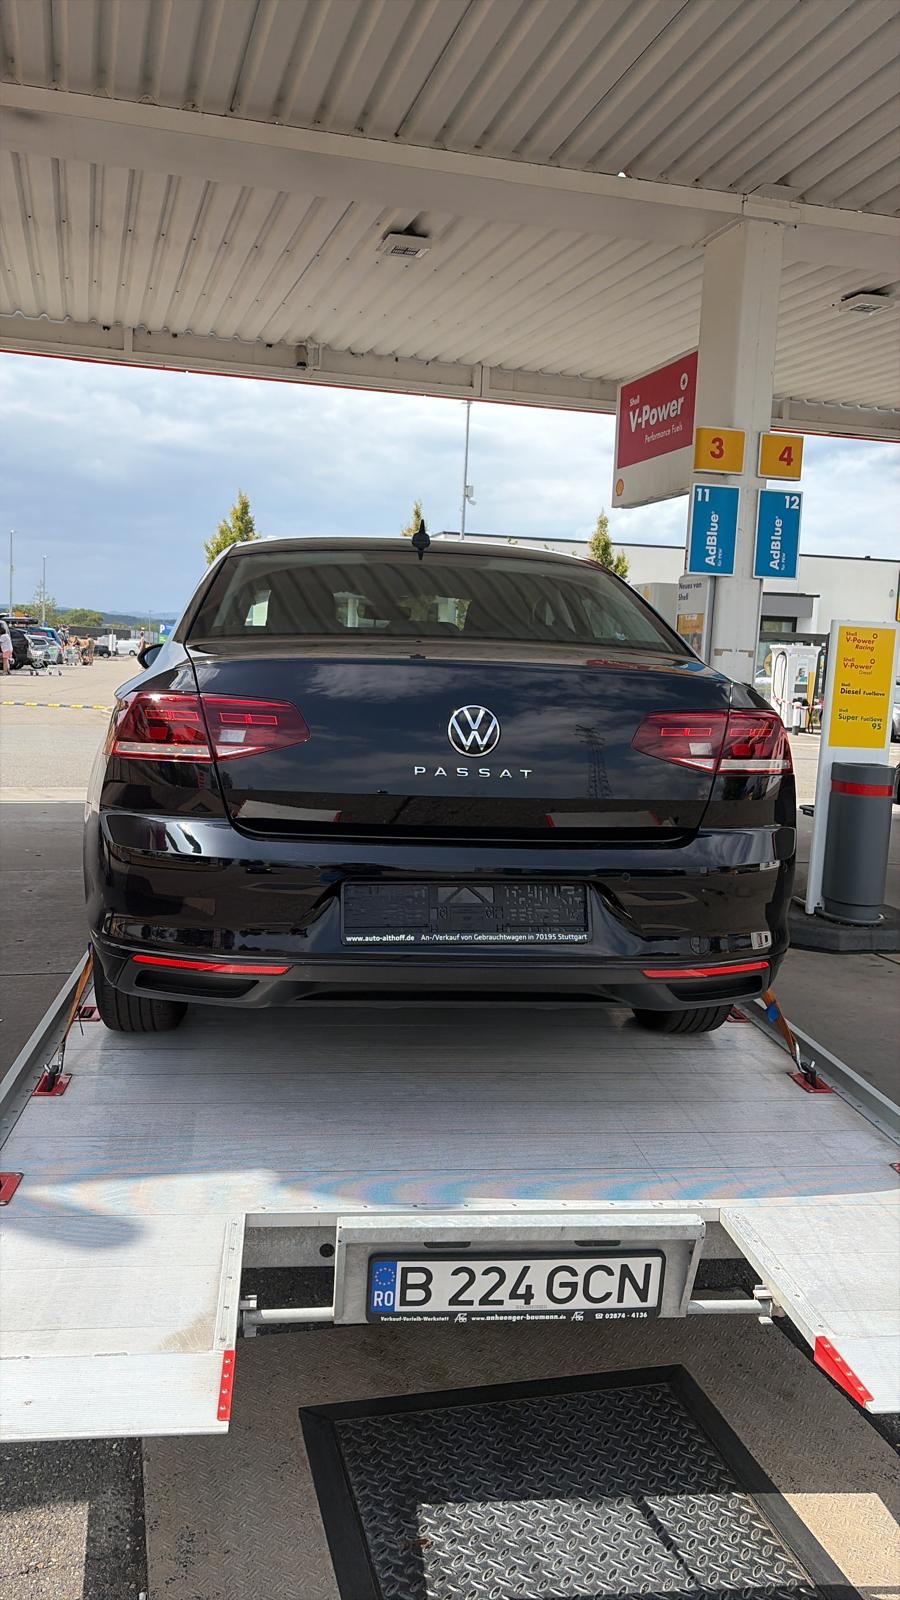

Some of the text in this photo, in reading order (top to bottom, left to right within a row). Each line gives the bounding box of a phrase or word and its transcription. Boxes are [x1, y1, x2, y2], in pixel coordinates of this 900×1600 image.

[629, 394, 640, 407] Shell
[629, 396, 685, 433] V-Power
[644, 420, 683, 444] Performance Fuels
[709, 437, 725, 459] 3
[778, 446, 794, 466] 4
[696, 488, 710, 502] 11
[784, 495, 800, 510] 12
[705, 513, 719, 566] AdBlue
[769, 518, 783, 570] AdBlue
[846, 636, 874, 644] V-Power
[855, 644, 875, 652] Racing
[840, 687, 862, 695] Diesel
[838, 713, 859, 723] Super
[449, 705, 500, 756] VW
[871, 722, 882, 730] 95
[414, 765, 533, 779] PASSAT
[346, 933, 415, 942] www.auto-althoff.de
[420, 933, 460, 941] An-/Verkauf
[473, 933, 527, 942] Gebrauchtwagen
[558, 933, 588, 942] Stuttgart
[398, 1263, 653, 1307] B 224 GCN
[373, 1290, 394, 1307] RO
[631, 1311, 648, 1319] 4136
